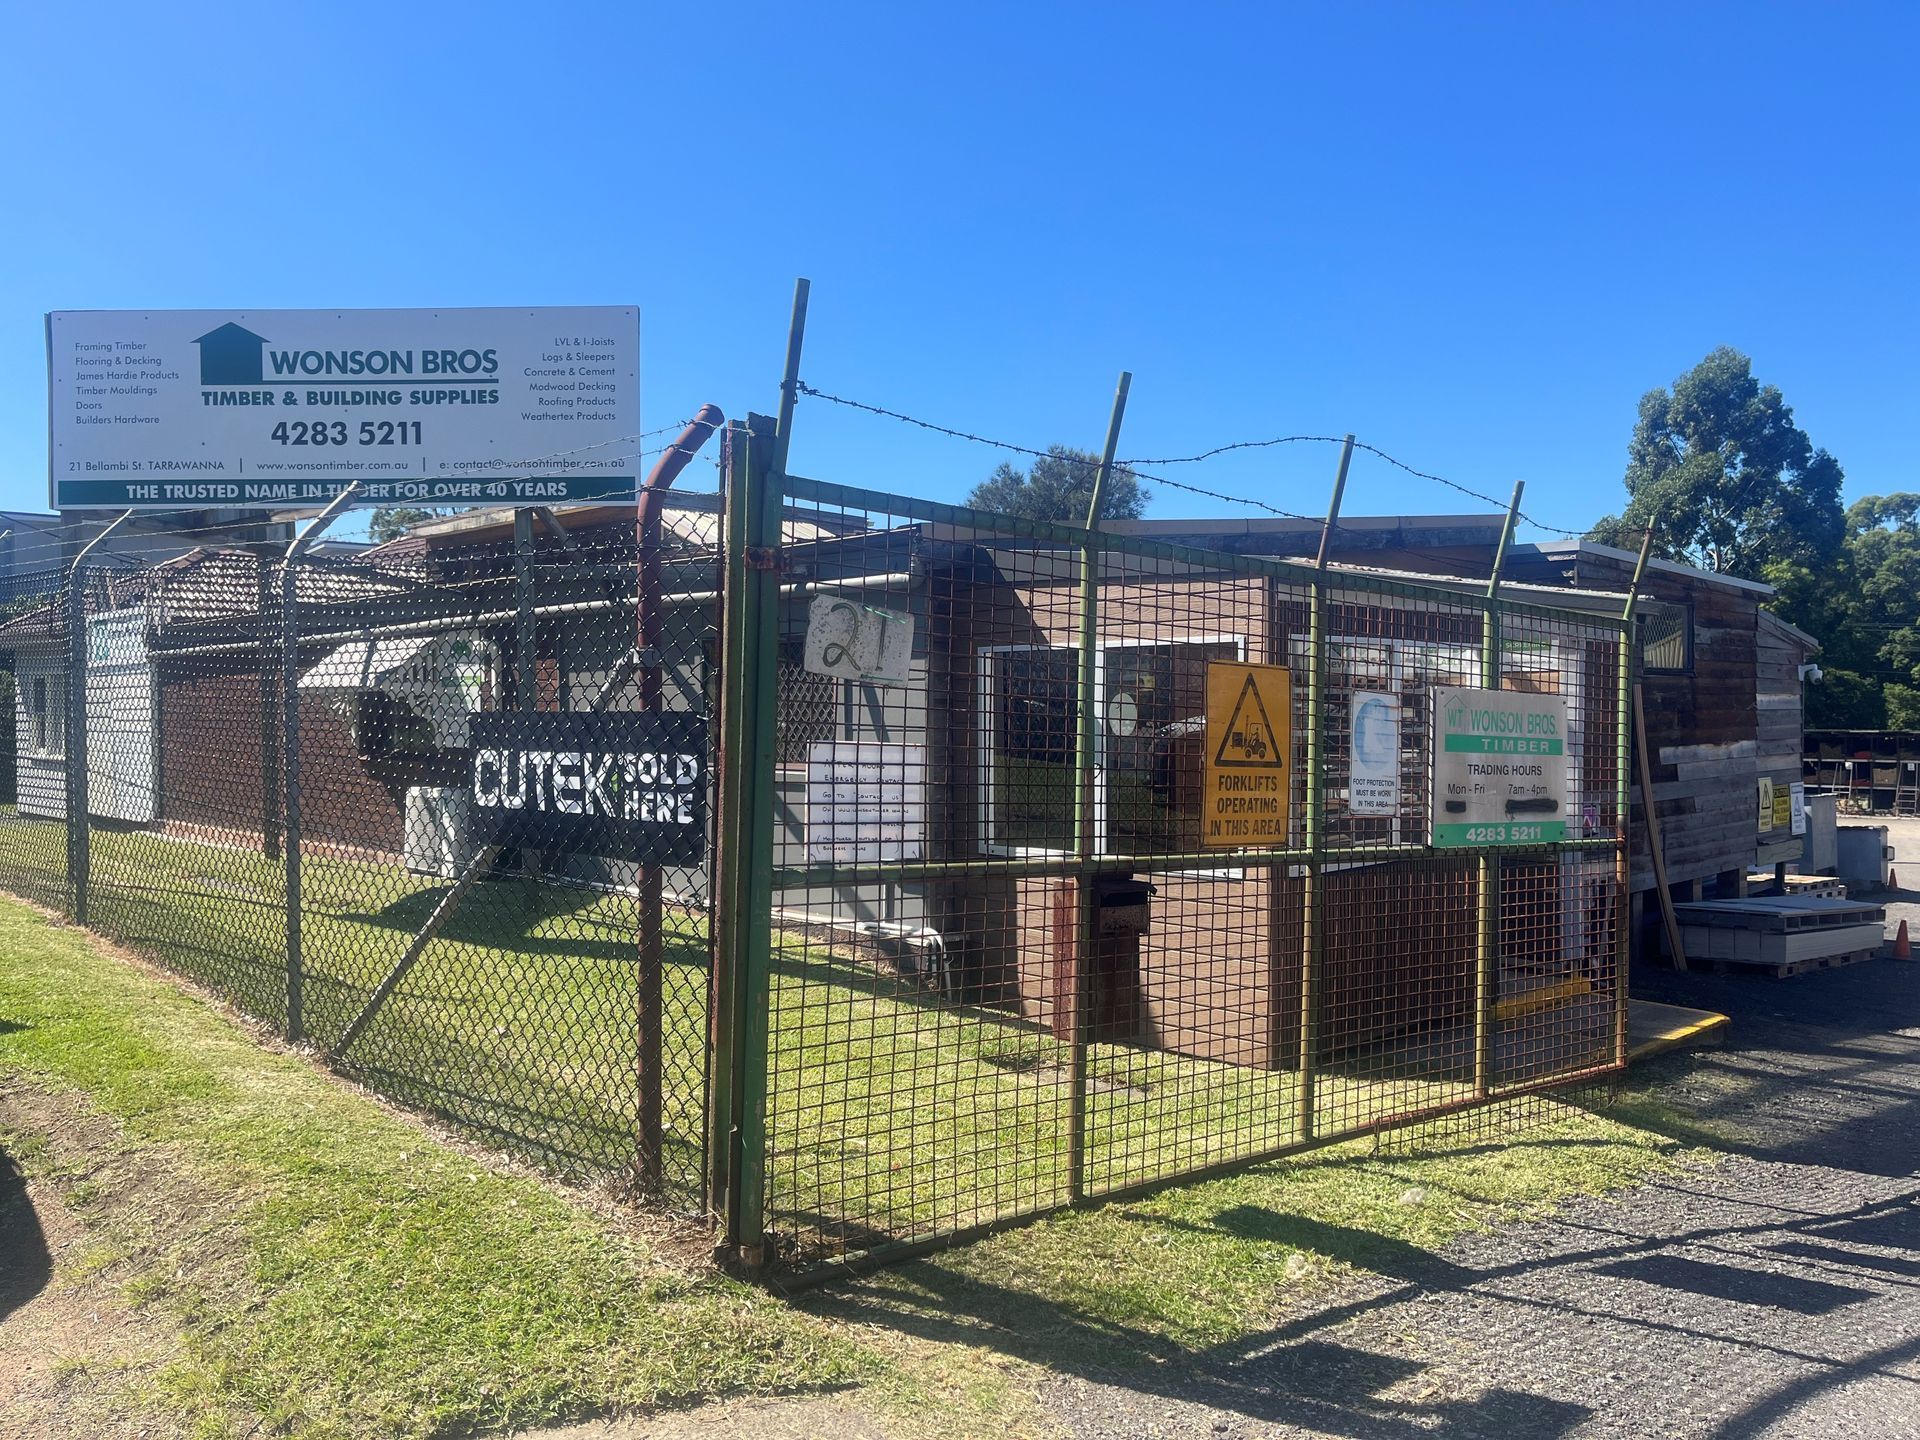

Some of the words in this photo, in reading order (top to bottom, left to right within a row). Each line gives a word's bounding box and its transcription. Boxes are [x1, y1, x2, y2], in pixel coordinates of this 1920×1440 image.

[75, 342, 112, 352] Framing
[115, 341, 147, 350] Timber
[554, 338, 571, 346] LVL
[574, 338, 580, 346] &
[584, 337, 615, 346] I-Joists
[75, 357, 112, 367] Flooring
[115, 356, 121, 365] &
[125, 356, 162, 366] Decking
[269, 350, 413, 375] WONSON
[422, 348, 499, 374] BROS
[542, 353, 563, 363] Logs
[566, 353, 572, 361] &
[576, 352, 615, 362] Sleepers
[76, 371, 104, 381] James
[107, 371, 137, 380] Hardie
[140, 371, 179, 380] Products
[524, 367, 566, 376] Concrete
[569, 368, 575, 376] &
[578, 367, 615, 376] Cement
[76, 386, 107, 395] Timber
[110, 386, 158, 396] Mouldings
[529, 382, 575, 391] Modwood
[578, 382, 616, 392] Decking
[201, 391, 275, 406] TIMBER
[282, 392, 299, 406] &
[306, 390, 403, 406] BUILDING
[409, 389, 500, 405] SUPPLIES
[538, 397, 574, 407] Roofing
[577, 396, 616, 405] Products
[76, 401, 102, 410] Doors
[76, 416, 112, 424] Builders
[114, 414, 160, 424] Hardware
[521, 412, 574, 421] Weathertex
[577, 411, 616, 420] Products
[271, 421, 348, 446] 4283
[358, 421, 422, 446] 5211
[68, 461, 81, 471] 21
[86, 461, 129, 471] Bellambi
[132, 460, 145, 470] St.
[147, 460, 224, 470] TARRAWANNA
[257, 460, 408, 470] www.wonsontimber.com.au
[126, 485, 159, 498] THE
[164, 484, 239, 498] TRUSTED
[245, 484, 296, 498] NAME
[302, 484, 323, 498] IN
[327, 484, 389, 498] TIER
[395, 484, 429, 497] FOR
[434, 484, 481, 497] OVER
[486, 483, 507, 496] 40
[512, 482, 568, 496] YEARS
[1470, 710, 1523, 734] WONSON
[1528, 714, 1558, 735] BROS.
[1481, 738, 1550, 753] TIMBER
[624, 752, 698, 786] SOLD
[1468, 764, 1509, 776] TRADING
[1512, 765, 1542, 776] HOURS
[474, 749, 616, 818] CUTEK
[1218, 775, 1278, 791] FORKLIFTS
[1448, 784, 1466, 794] Mon
[1474, 784, 1485, 794] Fri
[1508, 784, 1524, 795] 7am
[1531, 784, 1547, 796] 4pm
[624, 790, 694, 824] HERE
[1217, 798, 1278, 813] OPERATING
[1210, 820, 1221, 836] IN
[1225, 820, 1249, 836] THIS
[1252, 819, 1280, 835] AREA
[1466, 826, 1506, 842] 4283
[1511, 826, 1541, 840] 5211
